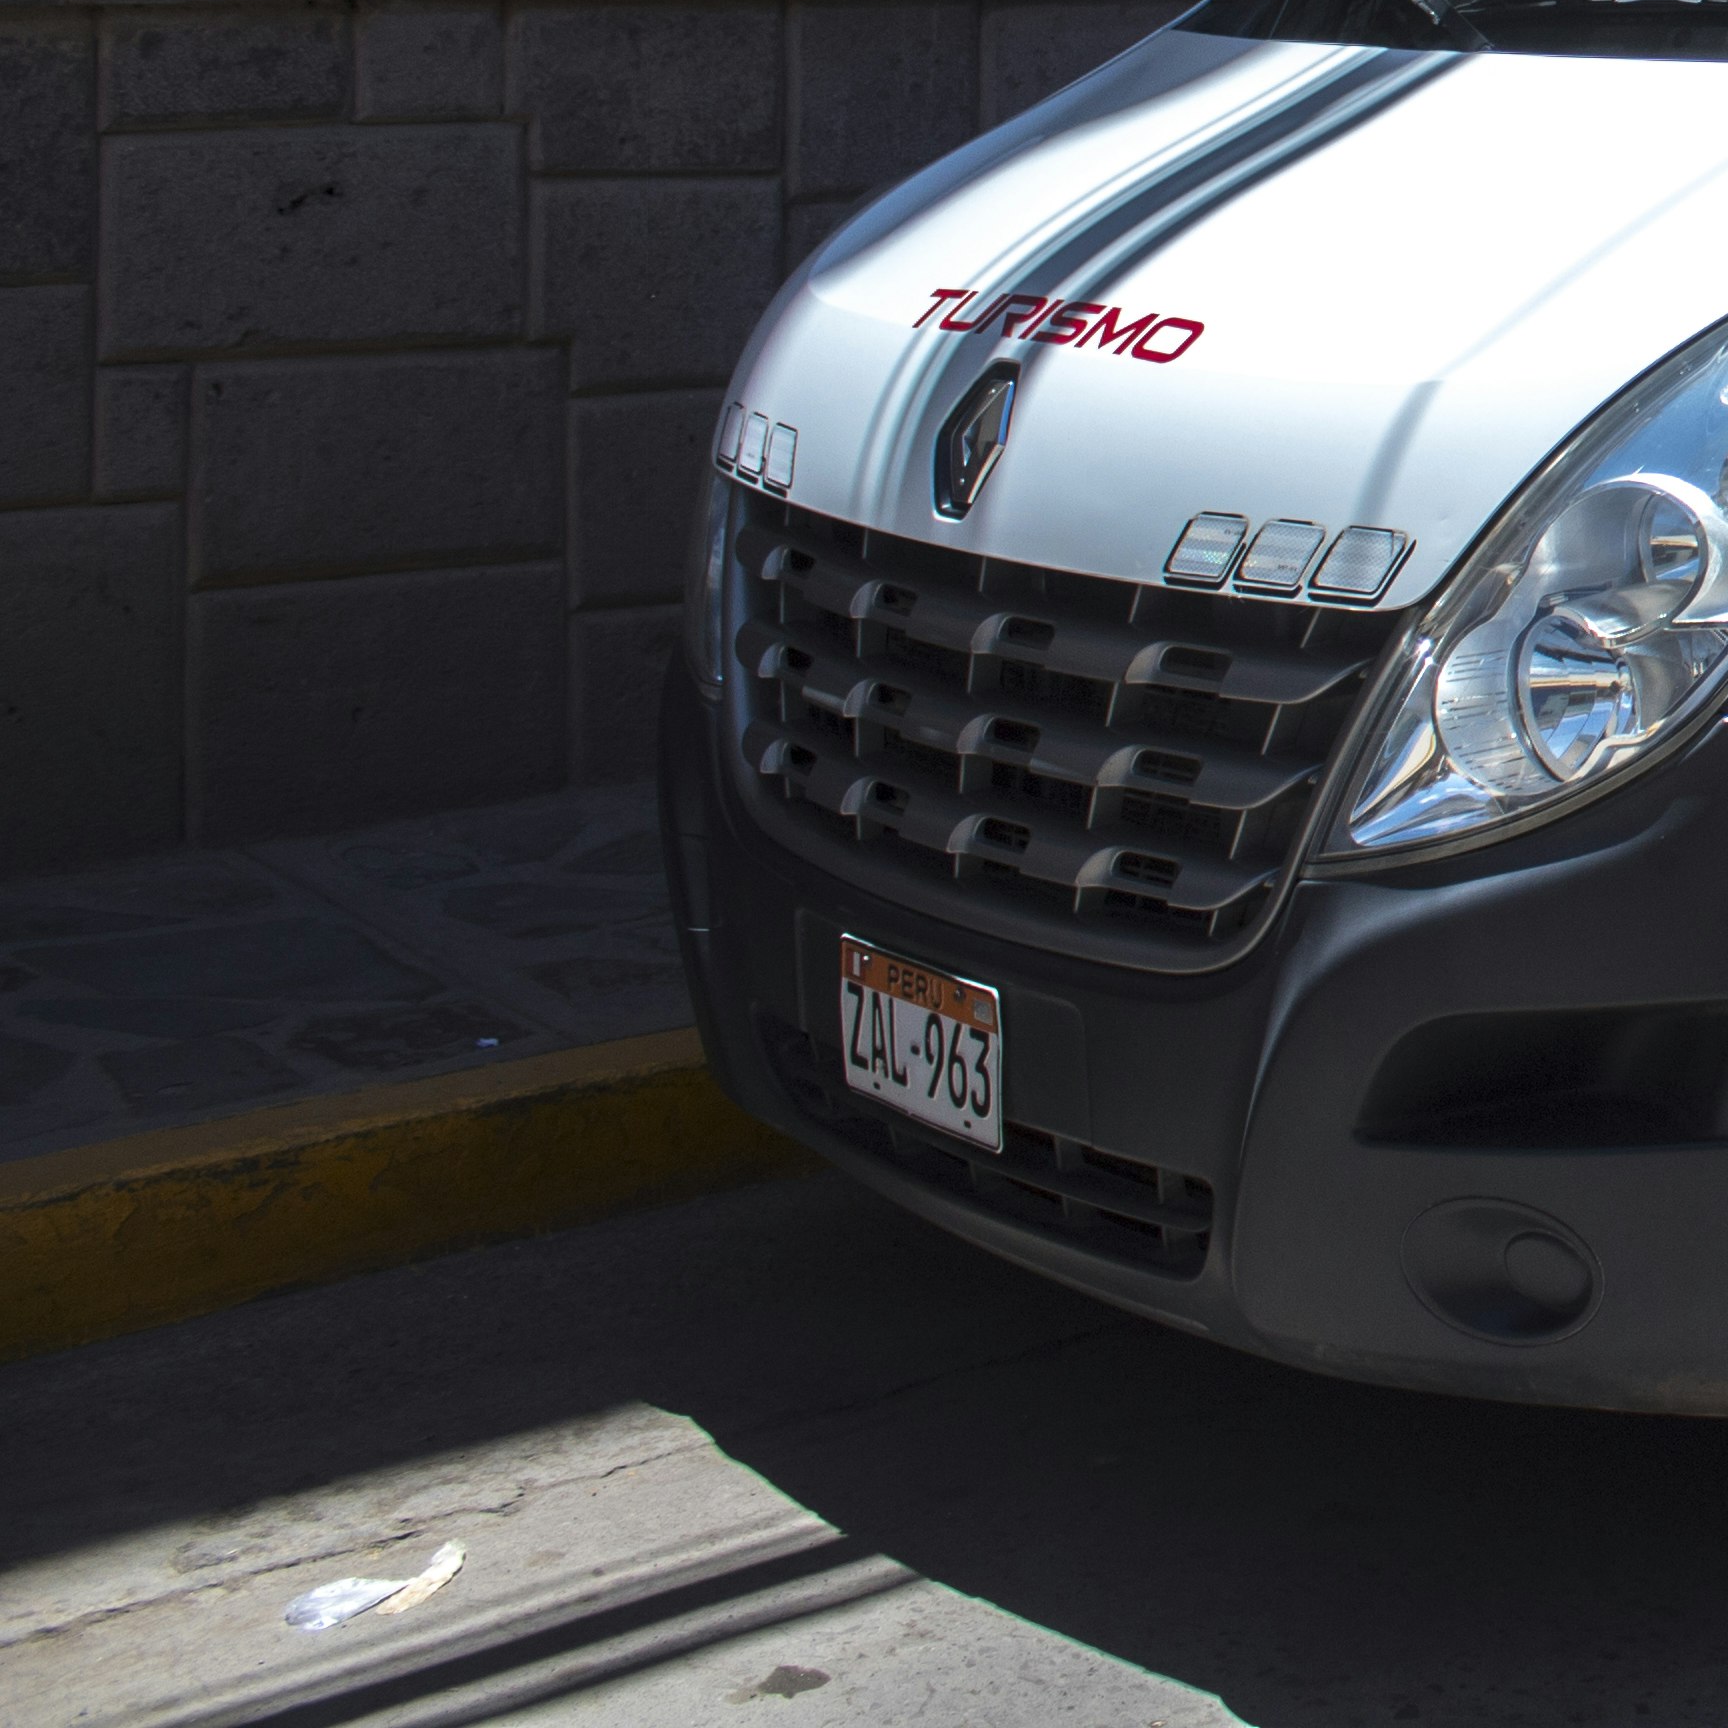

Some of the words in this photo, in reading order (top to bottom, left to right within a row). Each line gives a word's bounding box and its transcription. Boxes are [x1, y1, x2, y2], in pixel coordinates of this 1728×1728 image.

[911, 287, 1206, 365] TURISMO
[886, 962, 944, 1010] PERU
[847, 981, 992, 1119] ZAL-963
